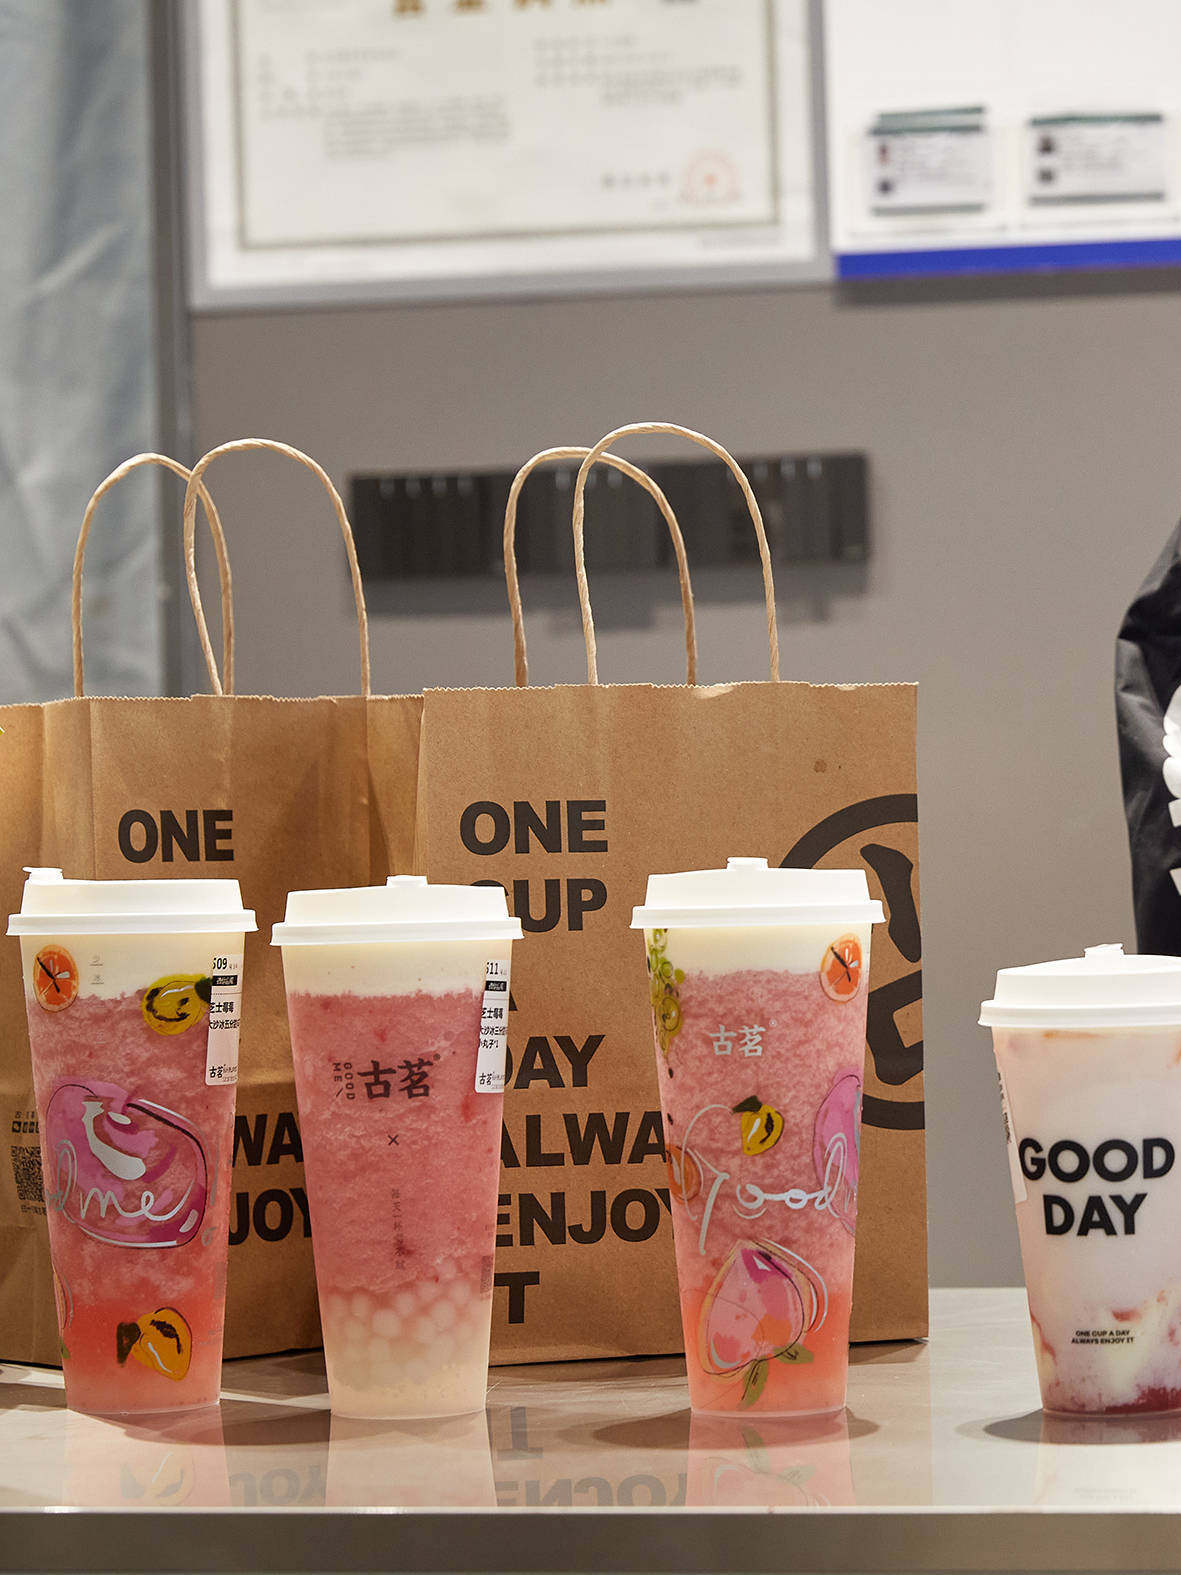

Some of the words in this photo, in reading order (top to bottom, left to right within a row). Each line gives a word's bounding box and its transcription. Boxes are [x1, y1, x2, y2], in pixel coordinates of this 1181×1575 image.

[118, 809, 234, 864] ONE
[460, 800, 608, 856] ONE
[470, 879, 608, 933] UP
[709, 1025, 766, 1056] 古茗
[344, 1063, 355, 1100] GOOD
[357, 1058, 433, 1099] 古茗
[1019, 1138, 1175, 1183] GOOD
[1043, 1193, 1148, 1236] DAY
